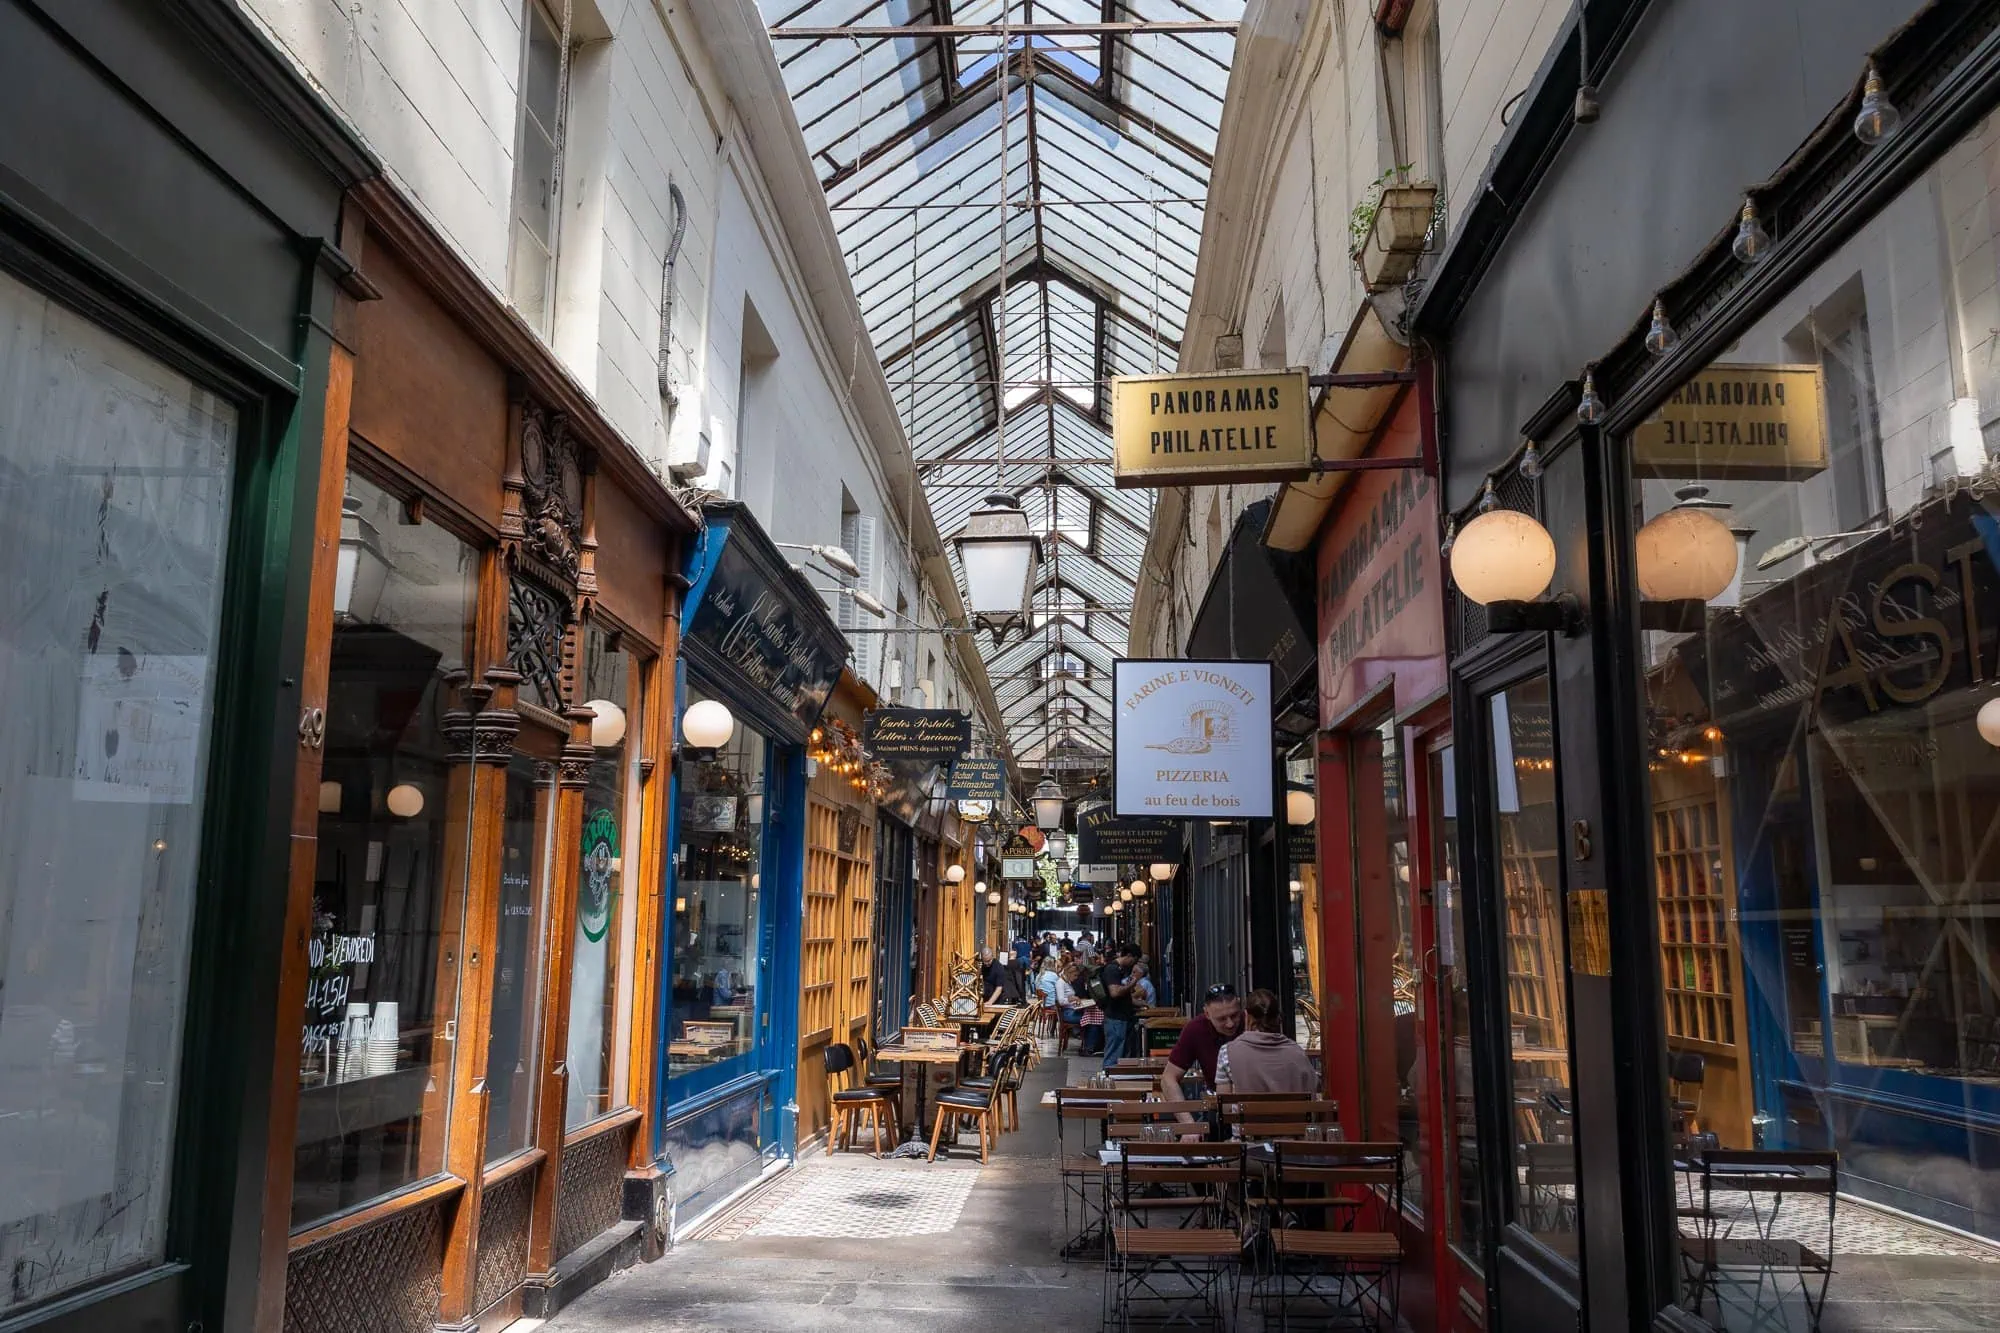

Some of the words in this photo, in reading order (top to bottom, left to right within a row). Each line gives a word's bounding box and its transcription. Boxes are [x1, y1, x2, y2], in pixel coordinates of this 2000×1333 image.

[1150, 386, 1279, 415] PANORAMAS
[1150, 426, 1277, 454] PHILATELIE
[1330, 534, 1425, 676] PHILATELIE
[1124, 672, 1178, 711] FARINE
[1179, 669, 1190, 682] E
[1193, 669, 1256, 707] VIGNETI
[298, 707, 324, 749] 49
[879, 716, 910, 729] Cartes
[914, 716, 956, 729] Postales
[871, 728, 907, 742] Lettres
[909, 730, 964, 742] Anciennes
[952, 772, 975, 780] Achat
[1155, 770, 1231, 783] PIZZERIA
[951, 781, 995, 789] Estimation
[968, 789, 1002, 798] Gratuite
[1144, 796, 1162, 806] au
[1165, 794, 1188, 806] feu
[1191, 794, 1209, 807] de
[1212, 794, 1241, 807] bois
